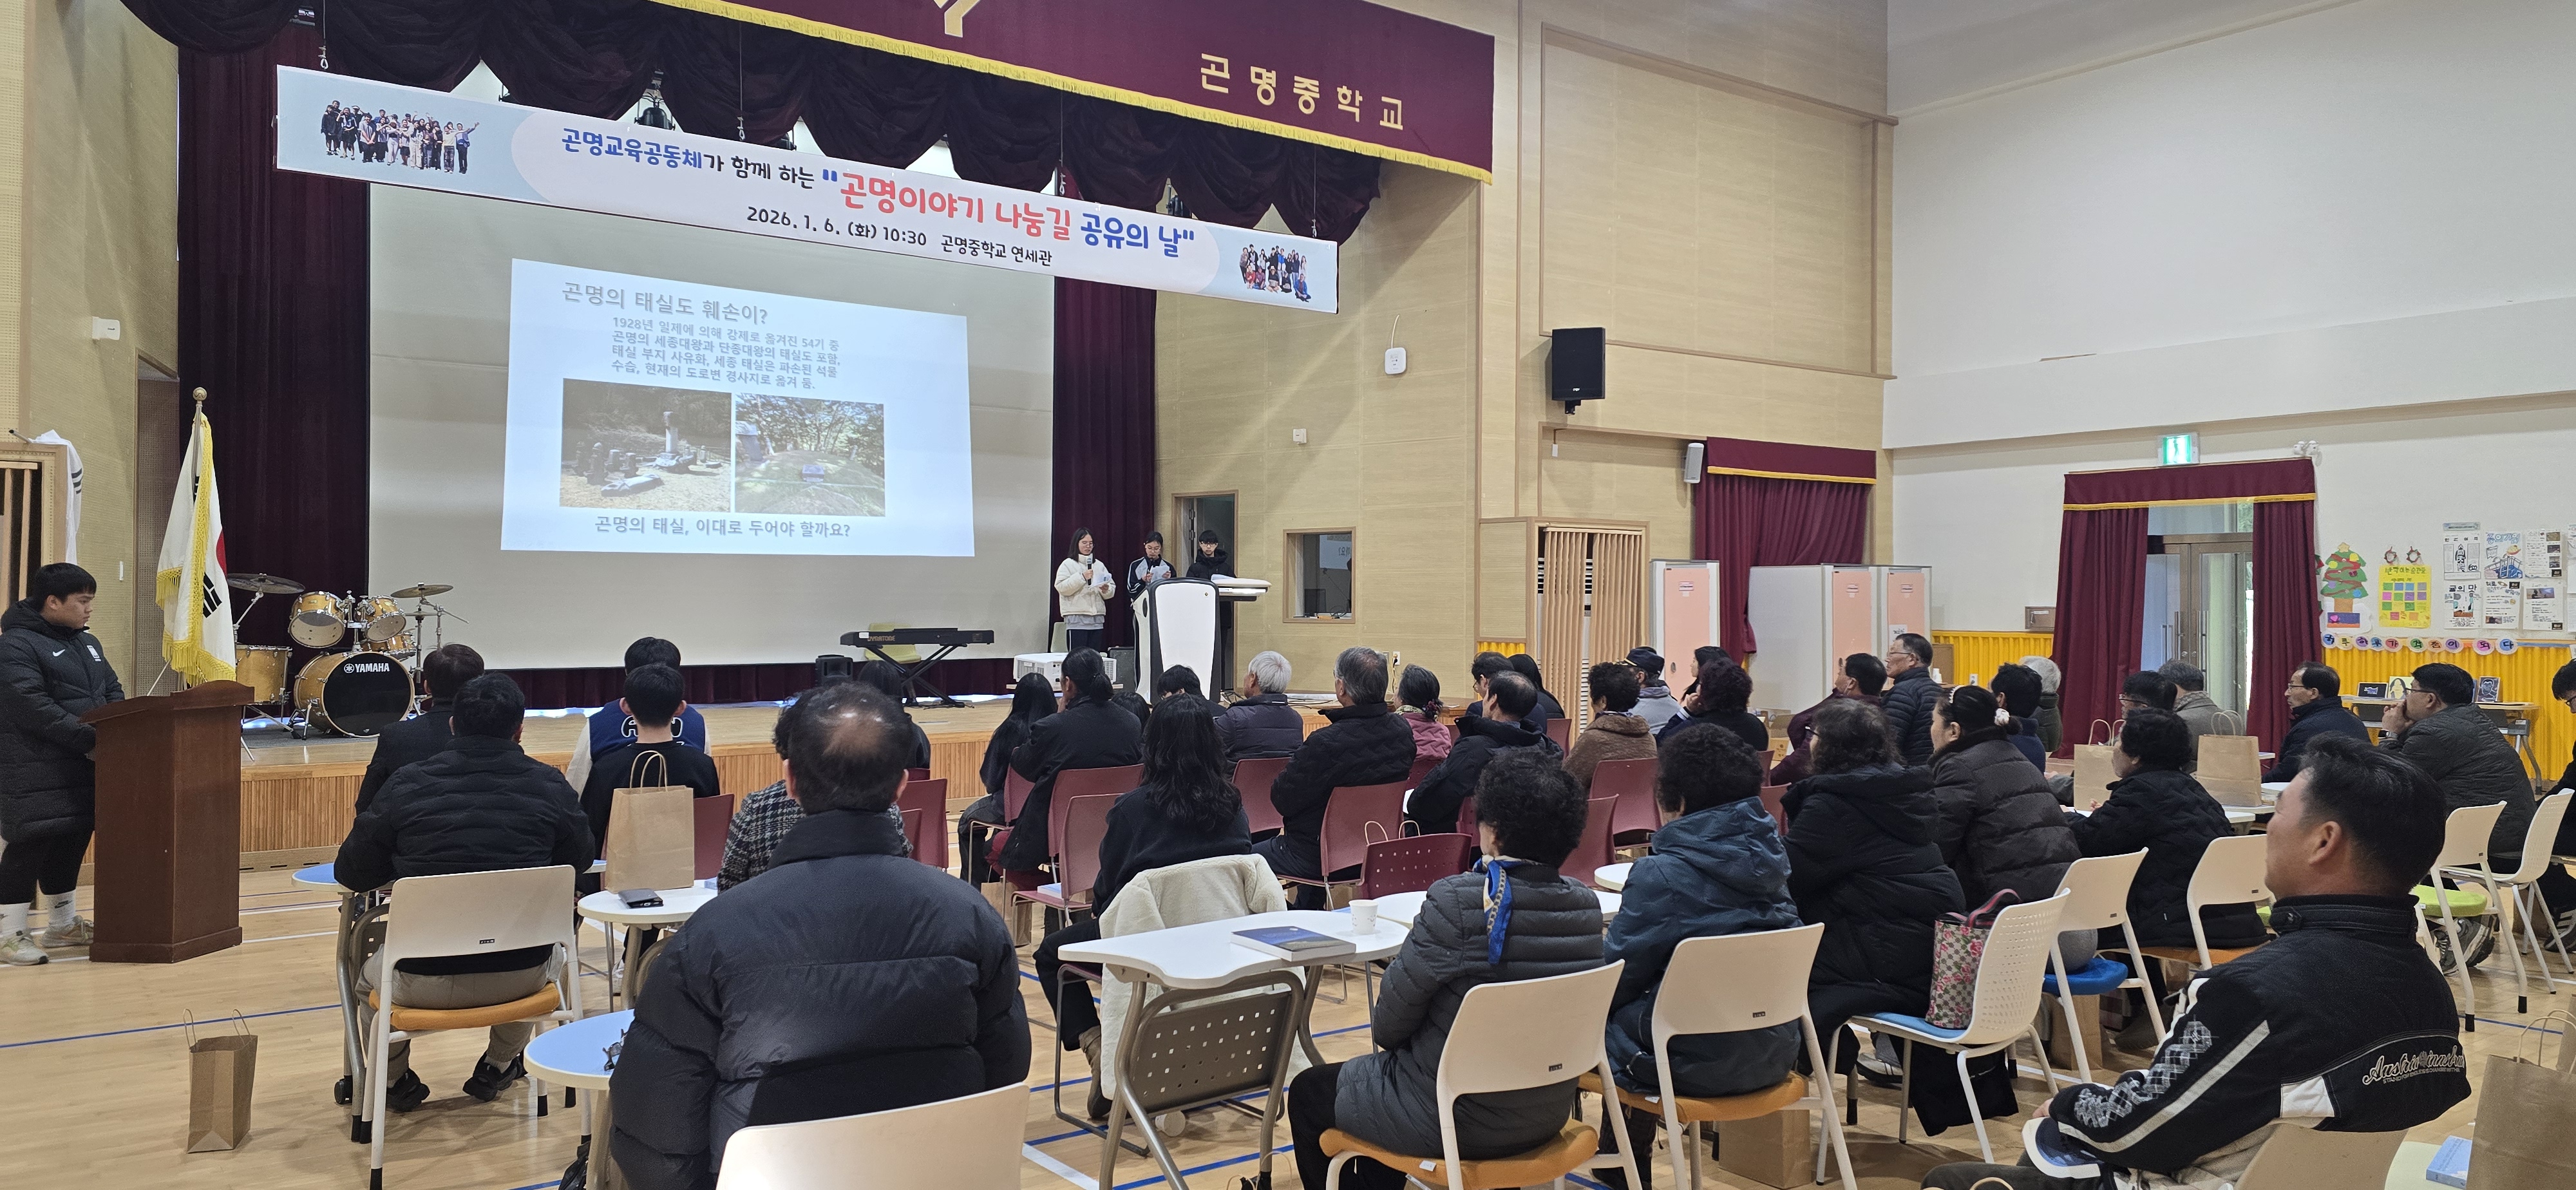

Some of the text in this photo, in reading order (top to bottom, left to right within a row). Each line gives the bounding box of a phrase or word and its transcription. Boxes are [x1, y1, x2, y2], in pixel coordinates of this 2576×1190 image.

[1201, 53, 1403, 130] 곤명중학교
[562, 128, 724, 172] 곤명교육공동체가
[731, 155, 771, 180] 함께
[778, 165, 815, 189] 하는
[996, 202, 1070, 241] 나눔길
[1081, 212, 1149, 249] 공유의
[1159, 225, 1195, 258] 날"
[746, 206, 1052, 267] 2026. 1. 6. (화) 10:30 곤명중학교 연세관
[562, 282, 768, 325] 곤명의 태실도 훼손이?
[612, 330, 649, 346] 곤명의
[654, 334, 715, 354] 세종대왕과
[719, 342, 775, 359] 단종대왕의
[780, 348, 813, 362] 태실도
[613, 317, 839, 352] 1928년 일제에 의해 강제로 옮겨진 54기 중
[611, 359, 640, 375] 수습,
[645, 361, 681, 378] 현재의
[686, 366, 721, 381] 도로변
[726, 370, 772, 386] 경사지로
[775, 375, 797, 389] 옮겨
[612, 345, 838, 379] 태실 부지 사유화, 세종 태실은 파손된 석물
[594, 516, 851, 538] 곤명의 태실, 이대로 두어야 할까요?
[355, 663, 390, 672] YAMAHA
